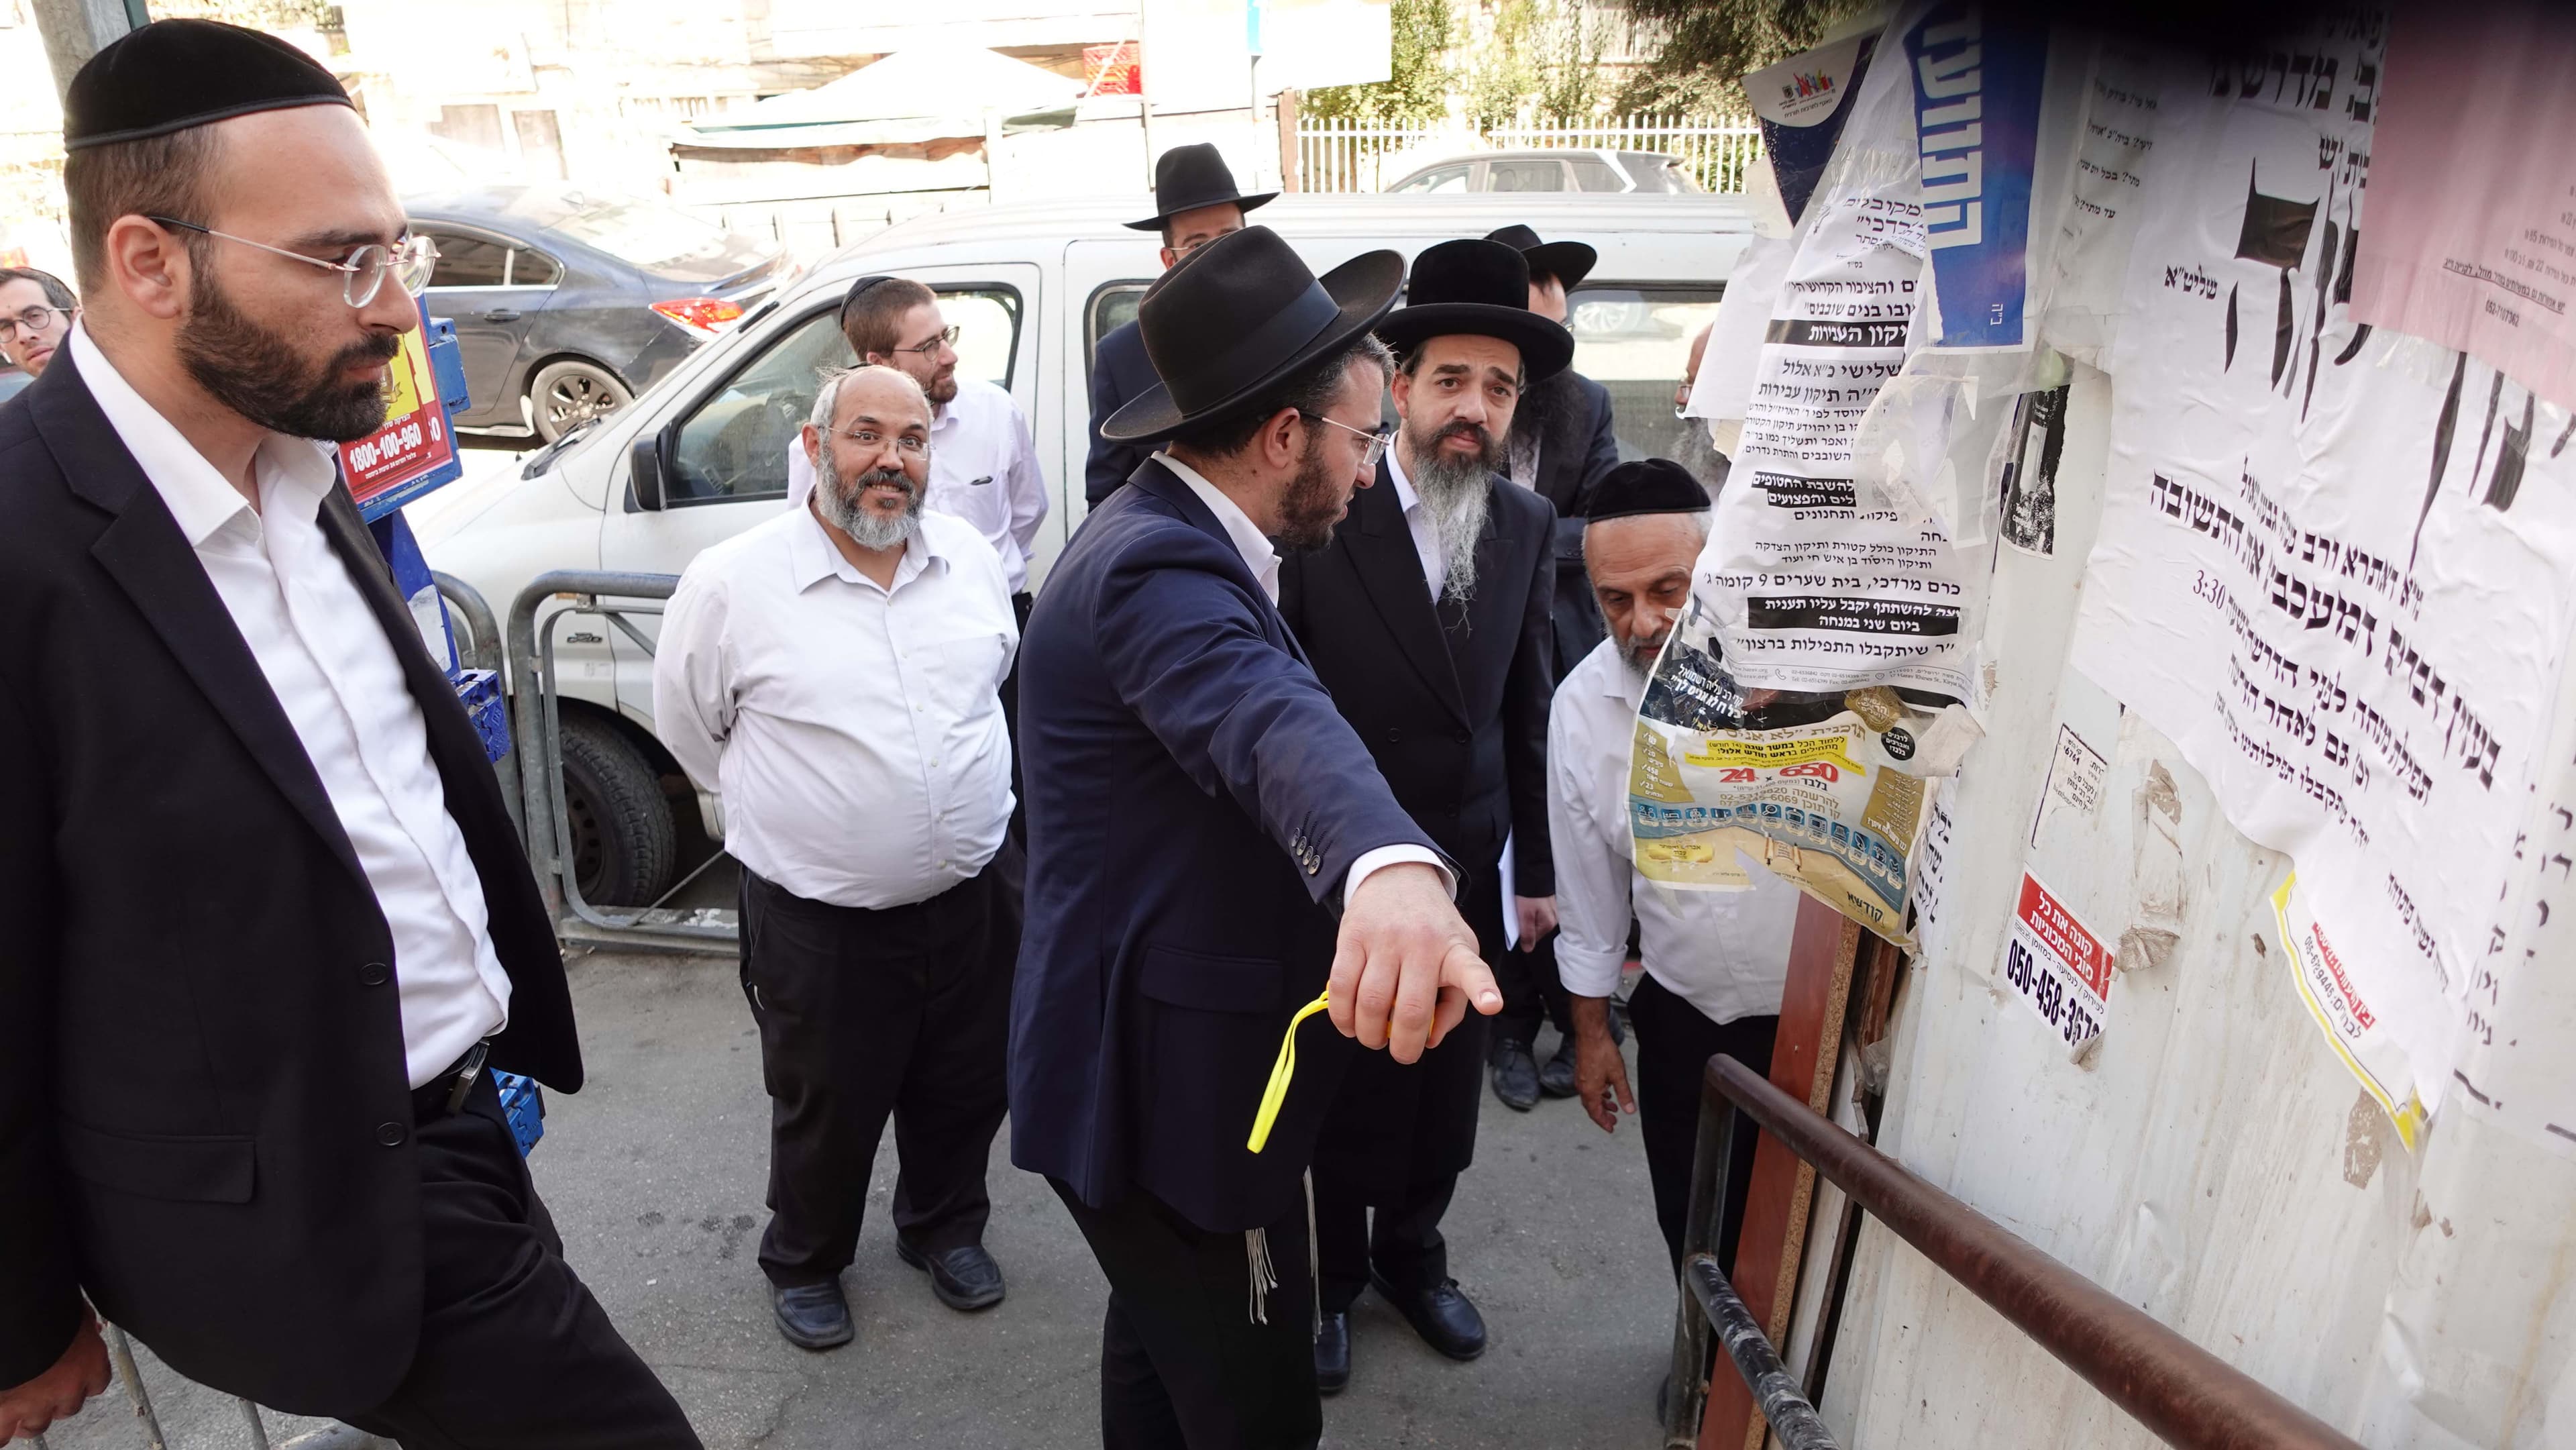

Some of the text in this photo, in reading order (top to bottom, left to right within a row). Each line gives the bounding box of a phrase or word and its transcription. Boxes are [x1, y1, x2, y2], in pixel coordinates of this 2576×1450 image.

[2101, 166, 2118, 180] בכל
[1843, 197, 1922, 217] מקובלים
[2104, 207, 2116, 218] עד
[1809, 279, 1894, 296] והציבור הקדוש
[2163, 258, 2218, 300] שליט"א
[1847, 303, 1882, 317] בנים
[1867, 324, 1908, 346] יקון
[1781, 358, 1812, 376] אלול
[1758, 382, 1841, 405] תיקון עבירות
[1813, 409, 1830, 418] לפי
[1773, 420, 1794, 432] תיקון
[1796, 423, 1831, 433] יהוידע
[1835, 424, 1845, 433] בן
[349, 421, 422, 474] 1800-100-960
[1782, 435, 1817, 447] ותשליך
[1821, 438, 1847, 446] ואפר
[1772, 448, 1851, 461] השובבים והתרת
[1752, 473, 1854, 492] להשבת החטופים
[1767, 491, 1827, 506] והפצועים
[1794, 509, 1855, 521] ותחנונים
[2150, 467, 2244, 557] התשובה
[1755, 540, 1937, 556] התיקון כולל קטורת ותיקון הצדקה
[2241, 526, 2264, 582] את
[2302, 525, 2340, 572] ורב
[1781, 554, 1932, 569] ותיקון היסוד בן איש חי ועוד
[1759, 573, 1768, 586] 9
[2341, 541, 2399, 601] דאתרא
[1715, 575, 1754, 590] קומה
[1774, 574, 1826, 587] שערים
[1831, 576, 1862, 588] בית
[1867, 576, 1922, 591] מרדכי,
[1927, 580, 1960, 596] כרם
[1765, 597, 1931, 617] להשתתף יקבל עליו תענית
[1818, 614, 1921, 632] ביום שני במנחה
[1790, 637, 1855, 654] התפילות
[1860, 641, 1929, 660] שיתקבלו
[1678, 663, 1707, 687] דשמואל
[1705, 678, 1723, 696] עליה
[2192, 569, 2432, 807] תפילת מנחה לפני הדרשה 3:30
[2263, 693, 2316, 746] לאחר
[1811, 722, 1866, 741] תוכנית
[1887, 731, 1909, 742] לרבנים
[2443, 685, 2502, 792] בענין
[1717, 743, 1838, 759] מתחילים בראש חודש אלול!
[1745, 742, 1764, 752] שנה
[1768, 742, 1795, 752] במשך
[2323, 727, 2349, 769] גם
[2240, 738, 2295, 784] תפילותינו
[1719, 762, 1839, 784] 24 650
[1801, 778, 1828, 791] בלבד
[1792, 786, 1839, 809] להרשמה
[1802, 798, 1825, 814] תוכן
[1829, 807, 1841, 821] קו
[1846, 890, 1885, 923] קודשא
[2038, 890, 2093, 960] קונה את כל
[2029, 910, 2094, 982] סוגי המכוניות
[2031, 936, 2052, 963] במזומן
[2056, 962, 2078, 988] לנסיעה
[2082, 988, 2104, 1015] לפירוק
